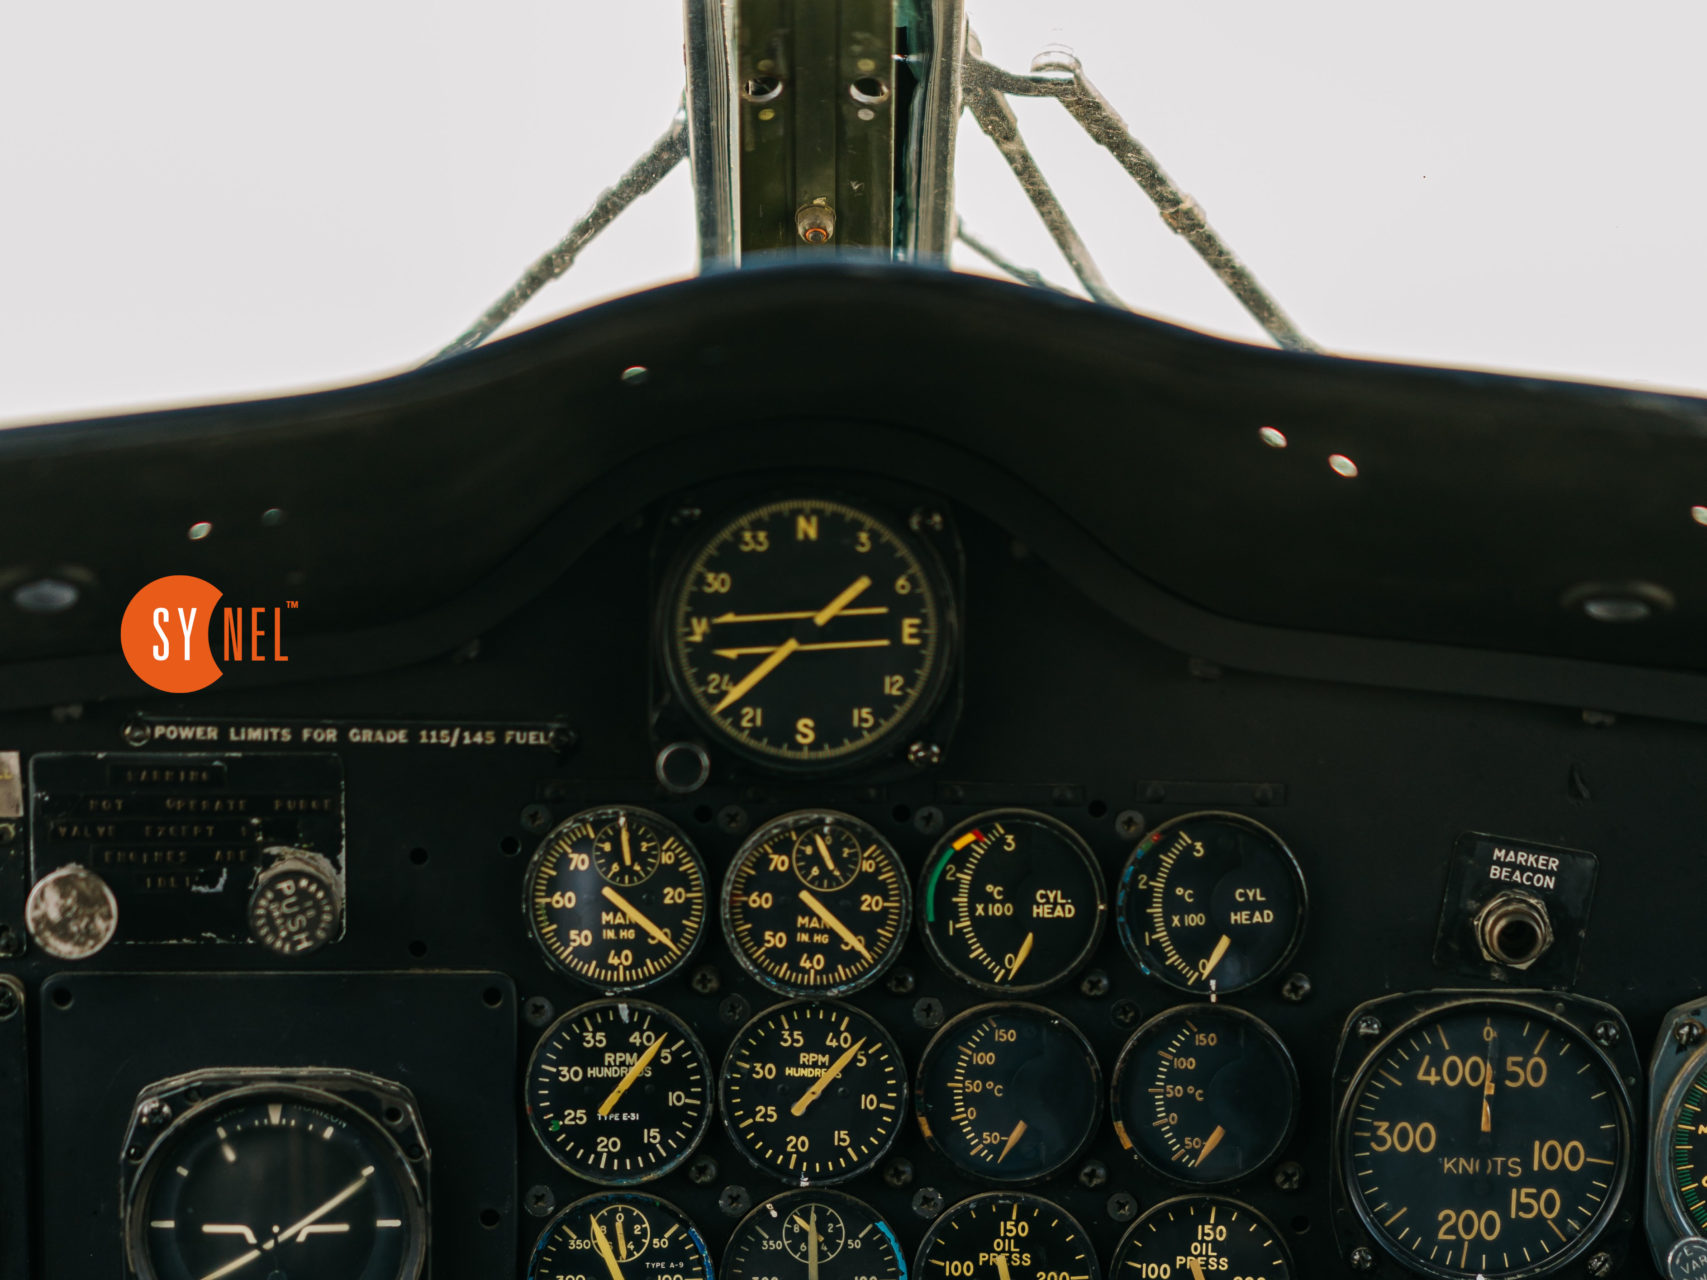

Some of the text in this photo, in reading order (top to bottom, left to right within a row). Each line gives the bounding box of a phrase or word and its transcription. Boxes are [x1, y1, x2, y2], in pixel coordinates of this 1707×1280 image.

[796, 515, 817, 541] N
[739, 530, 770, 552] 33
[703, 572, 731, 593] 30
[902, 618, 921, 644] E
[154, 725, 218, 741] POWER
[229, 727, 292, 742] LIMITS
[302, 728, 338, 742] FOR
[348, 728, 409, 743] GRADE
[419, 727, 496, 748] 115/145
[795, 718, 815, 744] S
[1003, 834, 1016, 852] 3
[1193, 842, 1205, 857] 3
[1492, 848, 1560, 872] MARKER
[946, 864, 956, 881] 2
[1489, 865, 1556, 890] BEACON
[551, 891, 576, 908] 60
[748, 891, 773, 908] 60
[860, 894, 883, 912] 20
[1036, 890, 1072, 904] CYL.
[1235, 888, 1266, 902] CYL
[275, 879, 314, 952] PUSH
[975, 903, 1014, 917] X 100
[1032, 905, 1076, 918] HEAD
[1230, 910, 1274, 925] HEAD
[1171, 913, 1206, 927] X 100
[569, 929, 592, 947] 50
[602, 929, 617, 940] IN.
[619, 929, 636, 940] HG
[796, 932, 811, 943] IN.
[813, 932, 829, 944] HG
[607, 949, 633, 966] 40
[799, 953, 825, 970] 40
[582, 1032, 607, 1048] 35
[780, 1030, 804, 1048] 35
[826, 1032, 852, 1048] 40
[994, 1029, 1017, 1042] 150
[1195, 1033, 1218, 1047] 150
[604, 1053, 638, 1066] RPM
[799, 1052, 829, 1066] RPM
[973, 1052, 996, 1066] 100
[1174, 1057, 1196, 1070] 100
[558, 1067, 583, 1082] 30
[752, 1063, 776, 1080] 30
[1416, 1055, 1486, 1088] 400
[965, 1080, 983, 1093] 50
[596, 1136, 621, 1152] 20
[1370, 1121, 1437, 1153] 300
[1000, 1221, 1029, 1237] 150
[993, 1239, 1020, 1252] OIL
[1191, 1242, 1218, 1256] OIL
[945, 1261, 974, 1277] 100
[1142, 1263, 1171, 1280] 100
